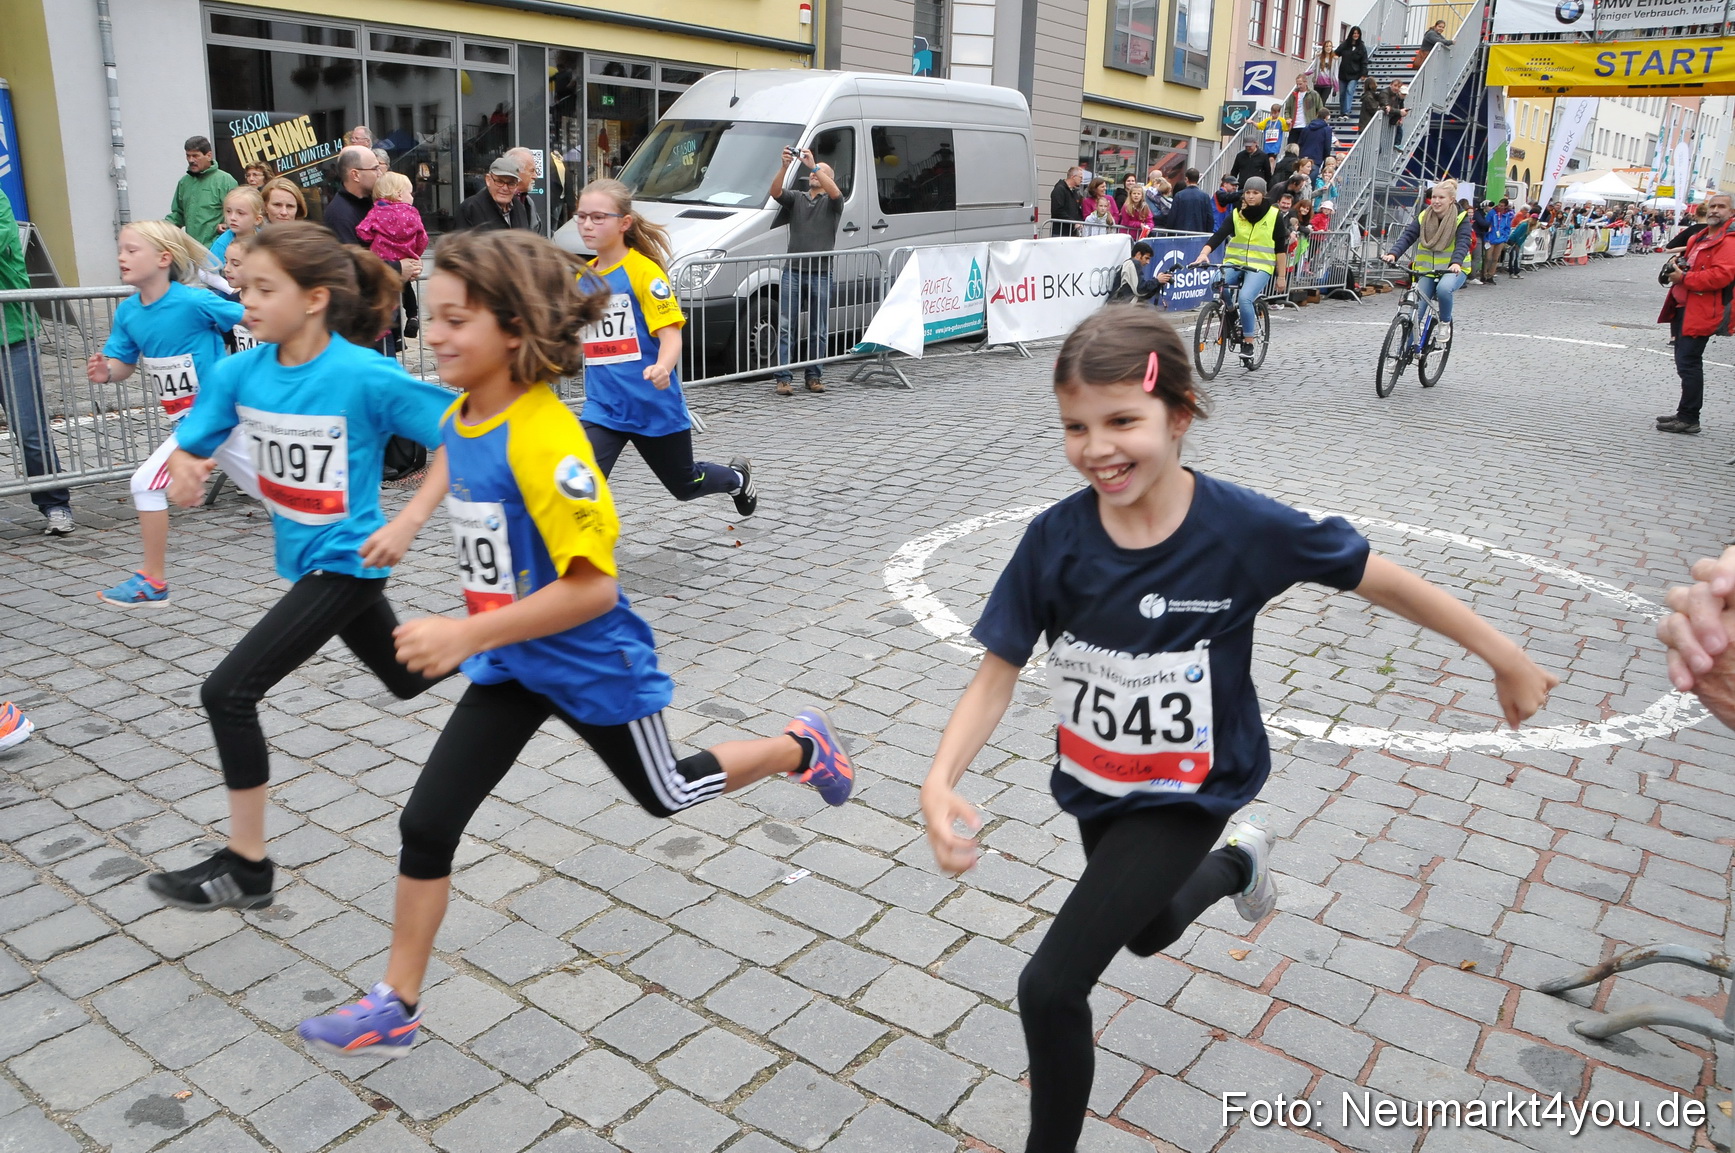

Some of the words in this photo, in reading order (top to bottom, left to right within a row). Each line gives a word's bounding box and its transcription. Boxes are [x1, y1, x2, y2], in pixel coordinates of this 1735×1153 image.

[1591, 11, 1632, 21] Weniger
[1634, 8, 1689, 18] Verbrauch.
[1692, 4, 1721, 14] Mehr
[1594, 47, 1724, 78] START
[229, 111, 270, 138] SEASON
[233, 114, 318, 169] OPENING
[276, 155, 296, 173] FALL
[298, 142, 331, 165] WINTER
[333, 138, 343, 152] 14
[1552, 155, 1566, 180] Audi
[1562, 130, 1576, 153] BKK
[990, 276, 1036, 304] Audi
[1043, 272, 1085, 300] BKK
[1167, 267, 1217, 289] ischer
[1049, 651, 1097, 675] PARTL
[1100, 665, 1176, 689] Neumarkt
[1062, 675, 1195, 746] 7543
[1092, 755, 1153, 776] Cecile
